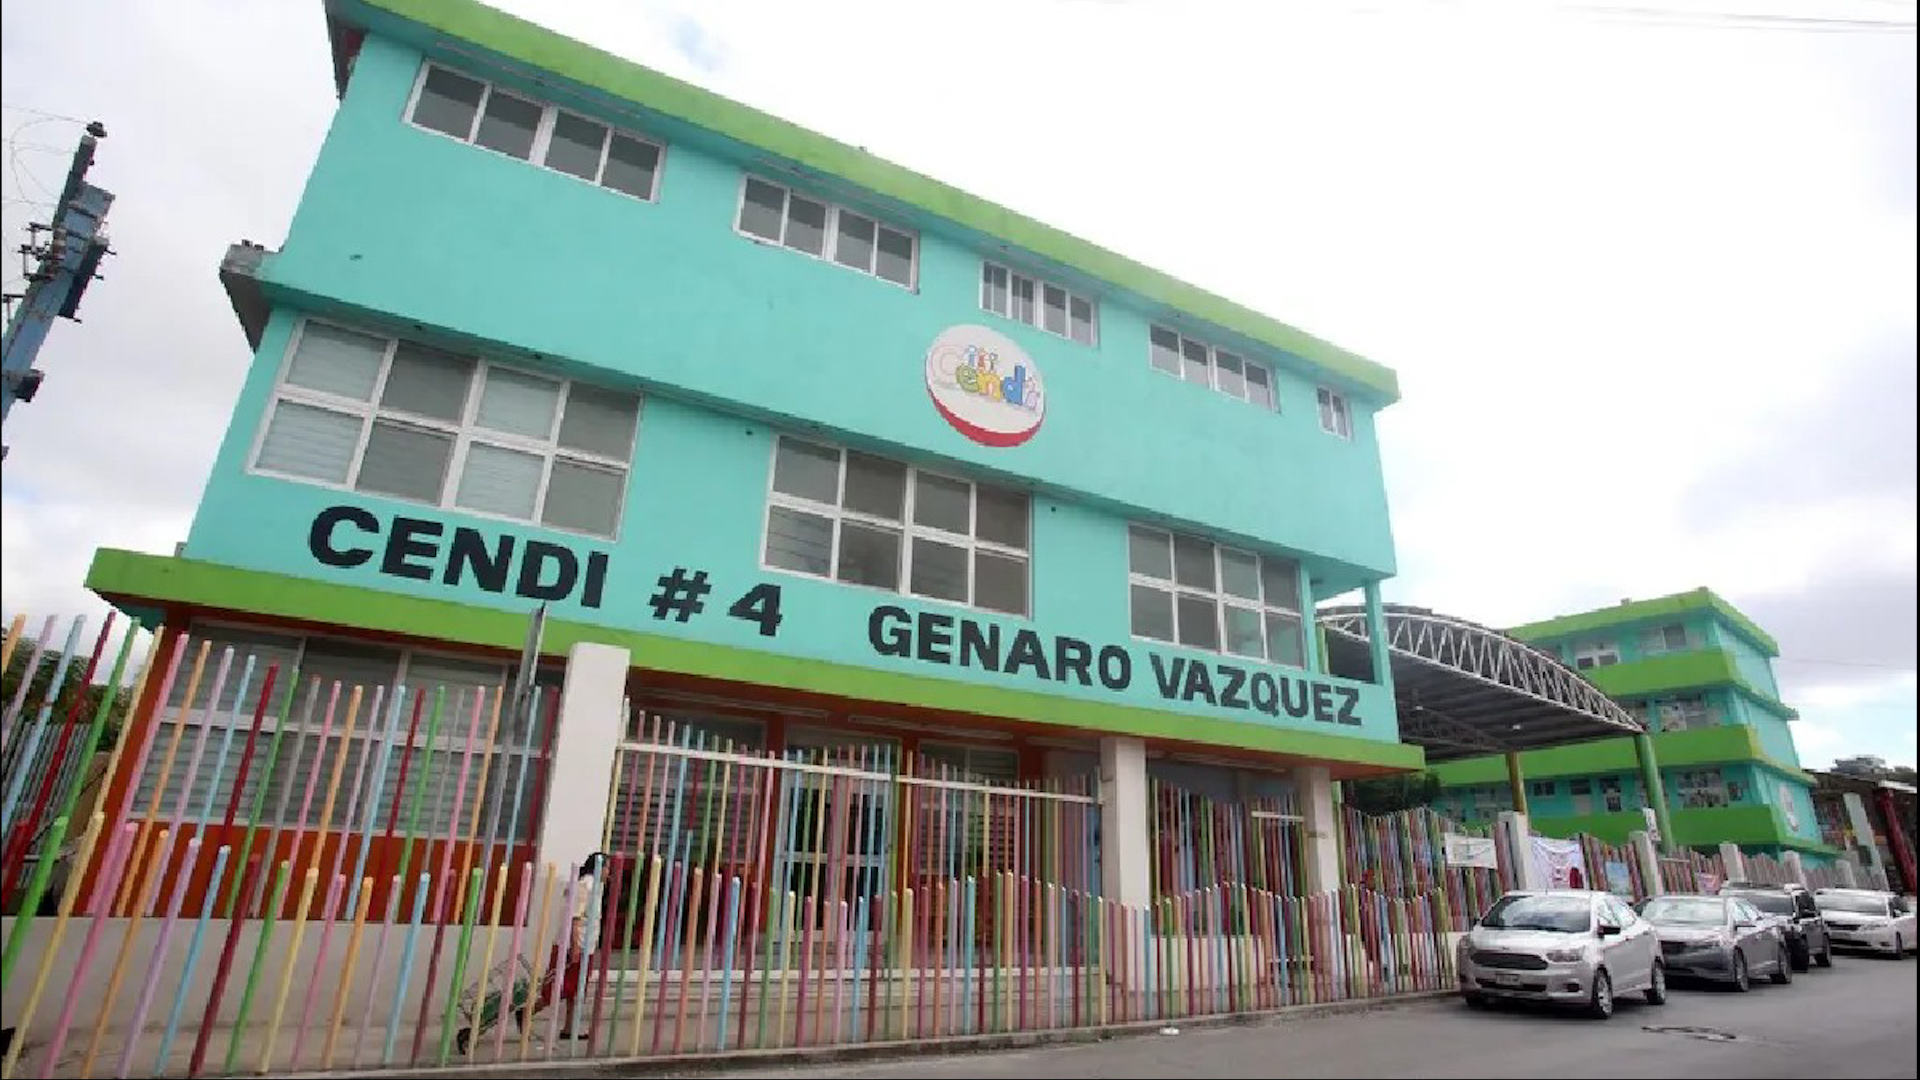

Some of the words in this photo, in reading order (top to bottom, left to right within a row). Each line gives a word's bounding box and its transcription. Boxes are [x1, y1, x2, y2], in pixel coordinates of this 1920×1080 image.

[307, 505, 609, 609] CENDI
[867, 604, 1132, 691] GENARO
[1149, 652, 1363, 727] VAZQUEZ
